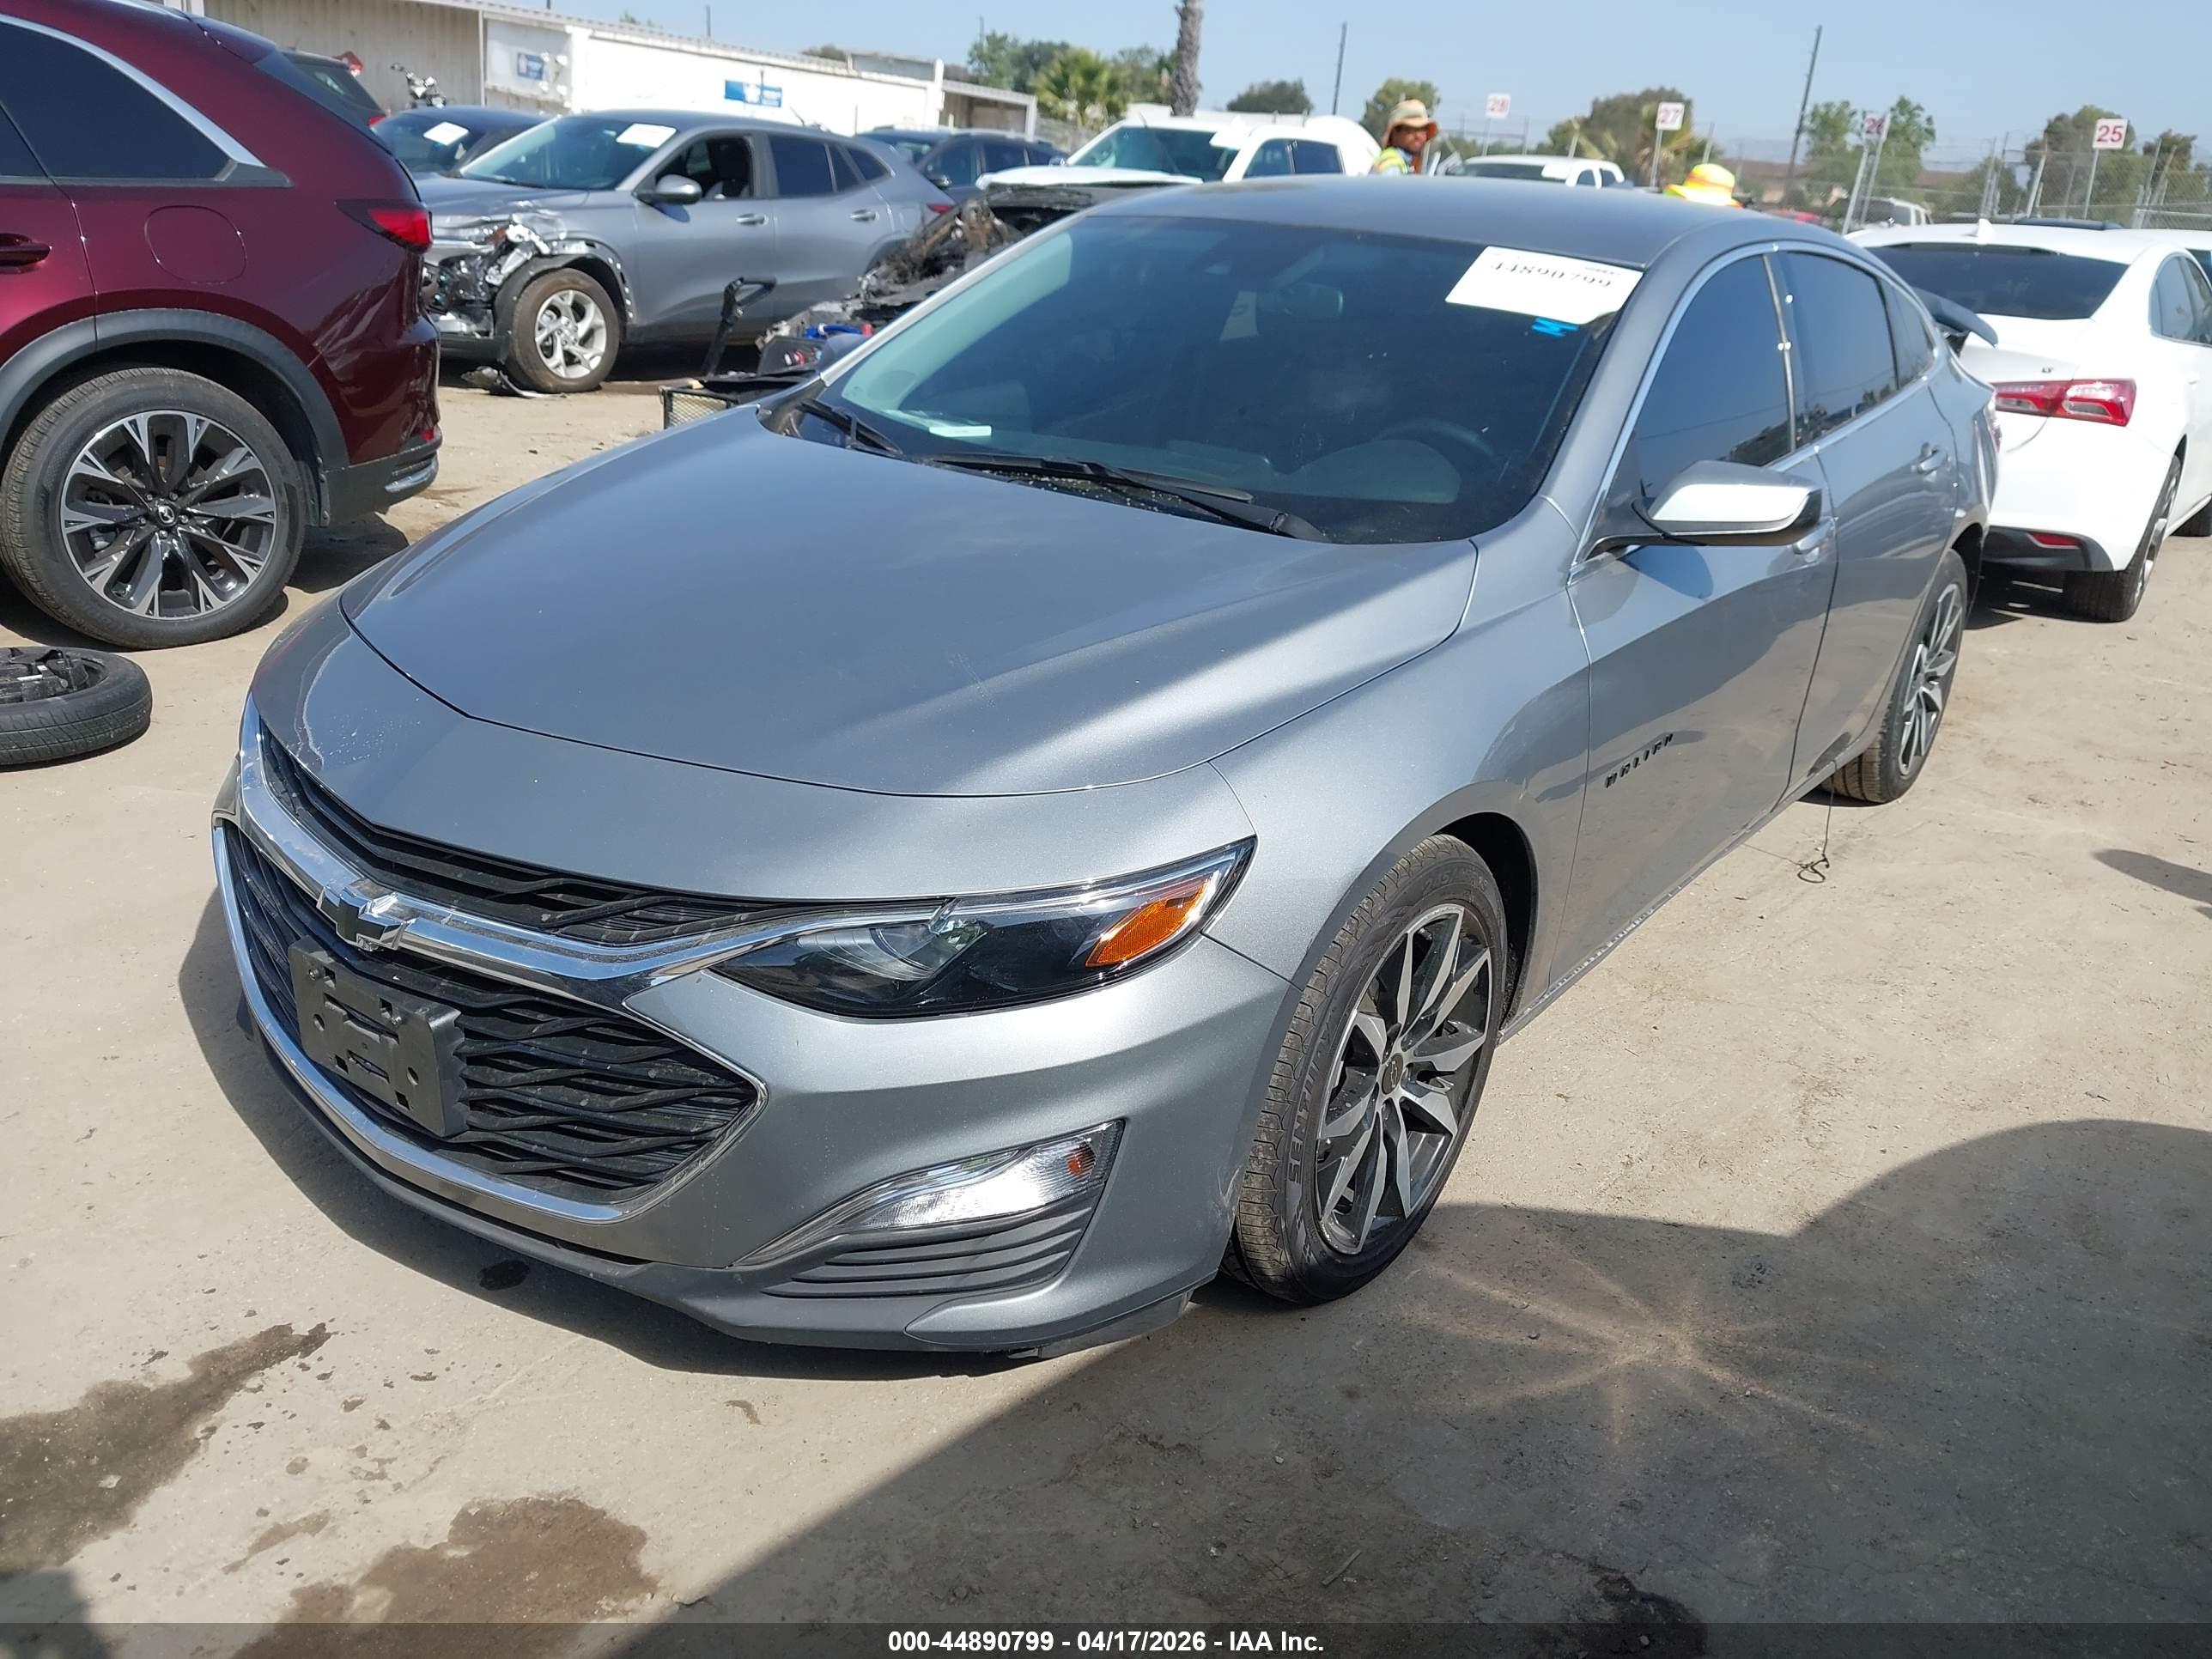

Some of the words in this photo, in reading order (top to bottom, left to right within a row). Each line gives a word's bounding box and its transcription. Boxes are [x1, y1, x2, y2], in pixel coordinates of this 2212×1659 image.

[1659, 107, 1684, 125] 27
[2096, 125, 2124, 143] 25
[1490, 261, 1612, 288] 44890799
